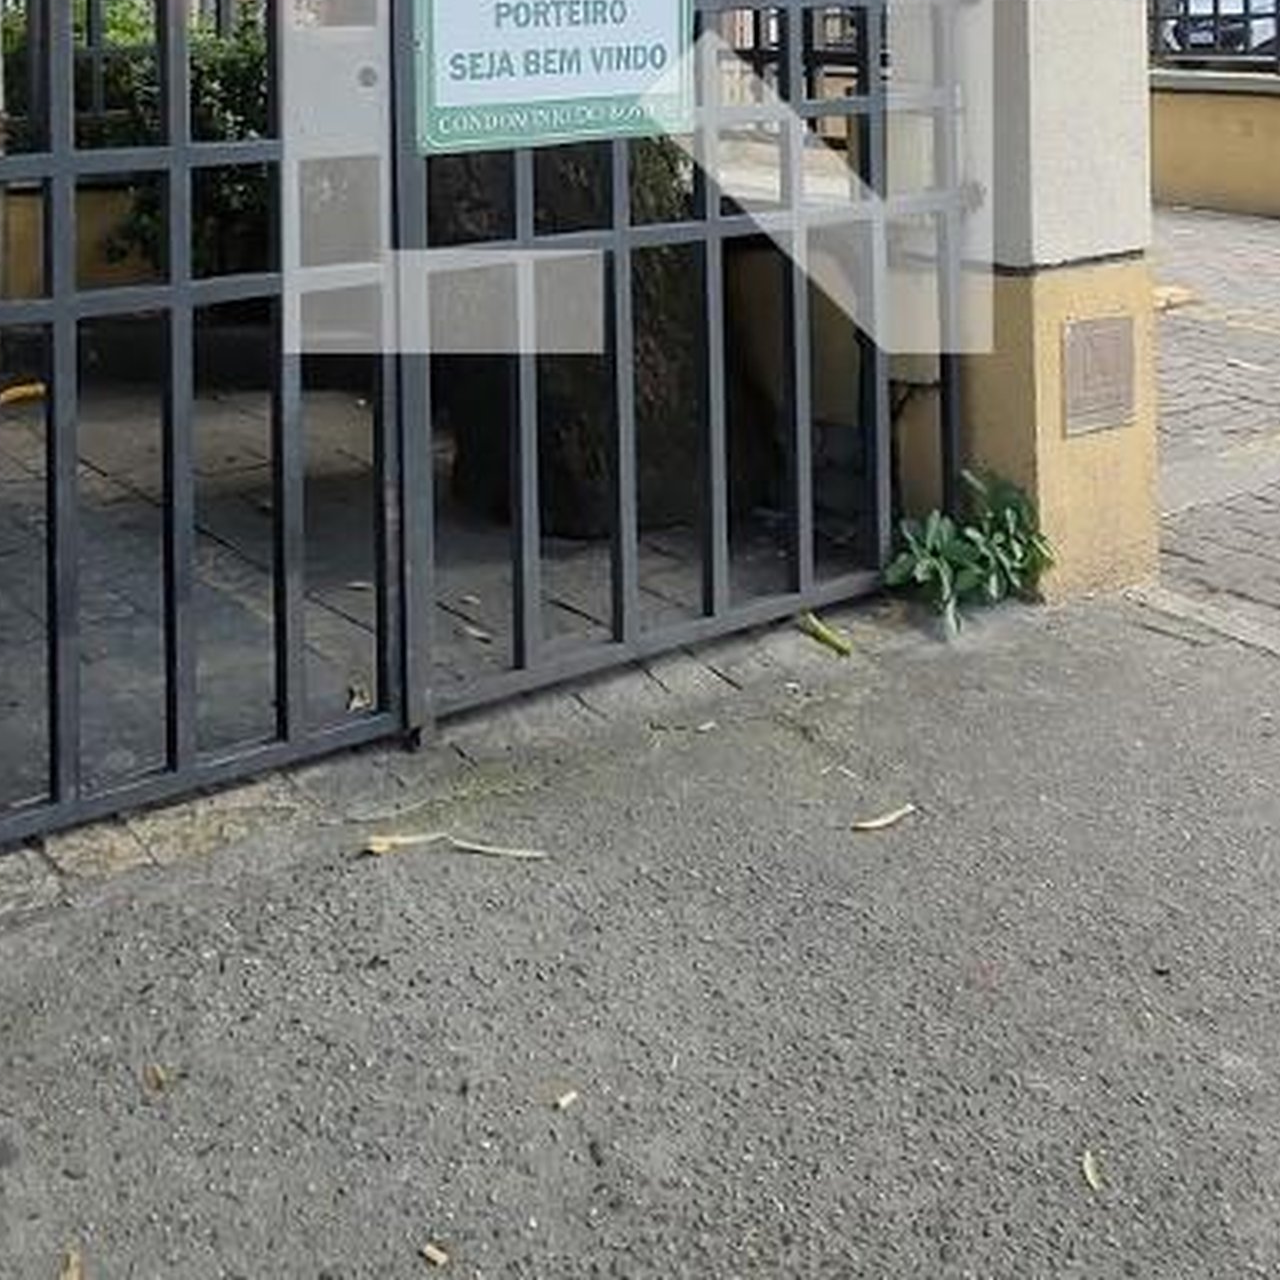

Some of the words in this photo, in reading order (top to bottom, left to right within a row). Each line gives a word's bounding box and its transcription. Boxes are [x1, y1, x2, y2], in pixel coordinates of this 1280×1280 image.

[495, 0, 627, 28] PORTEIRO
[449, 50, 516, 81] SEJA
[523, 47, 583, 77] BEM
[590, 42, 668, 72] VINDO
